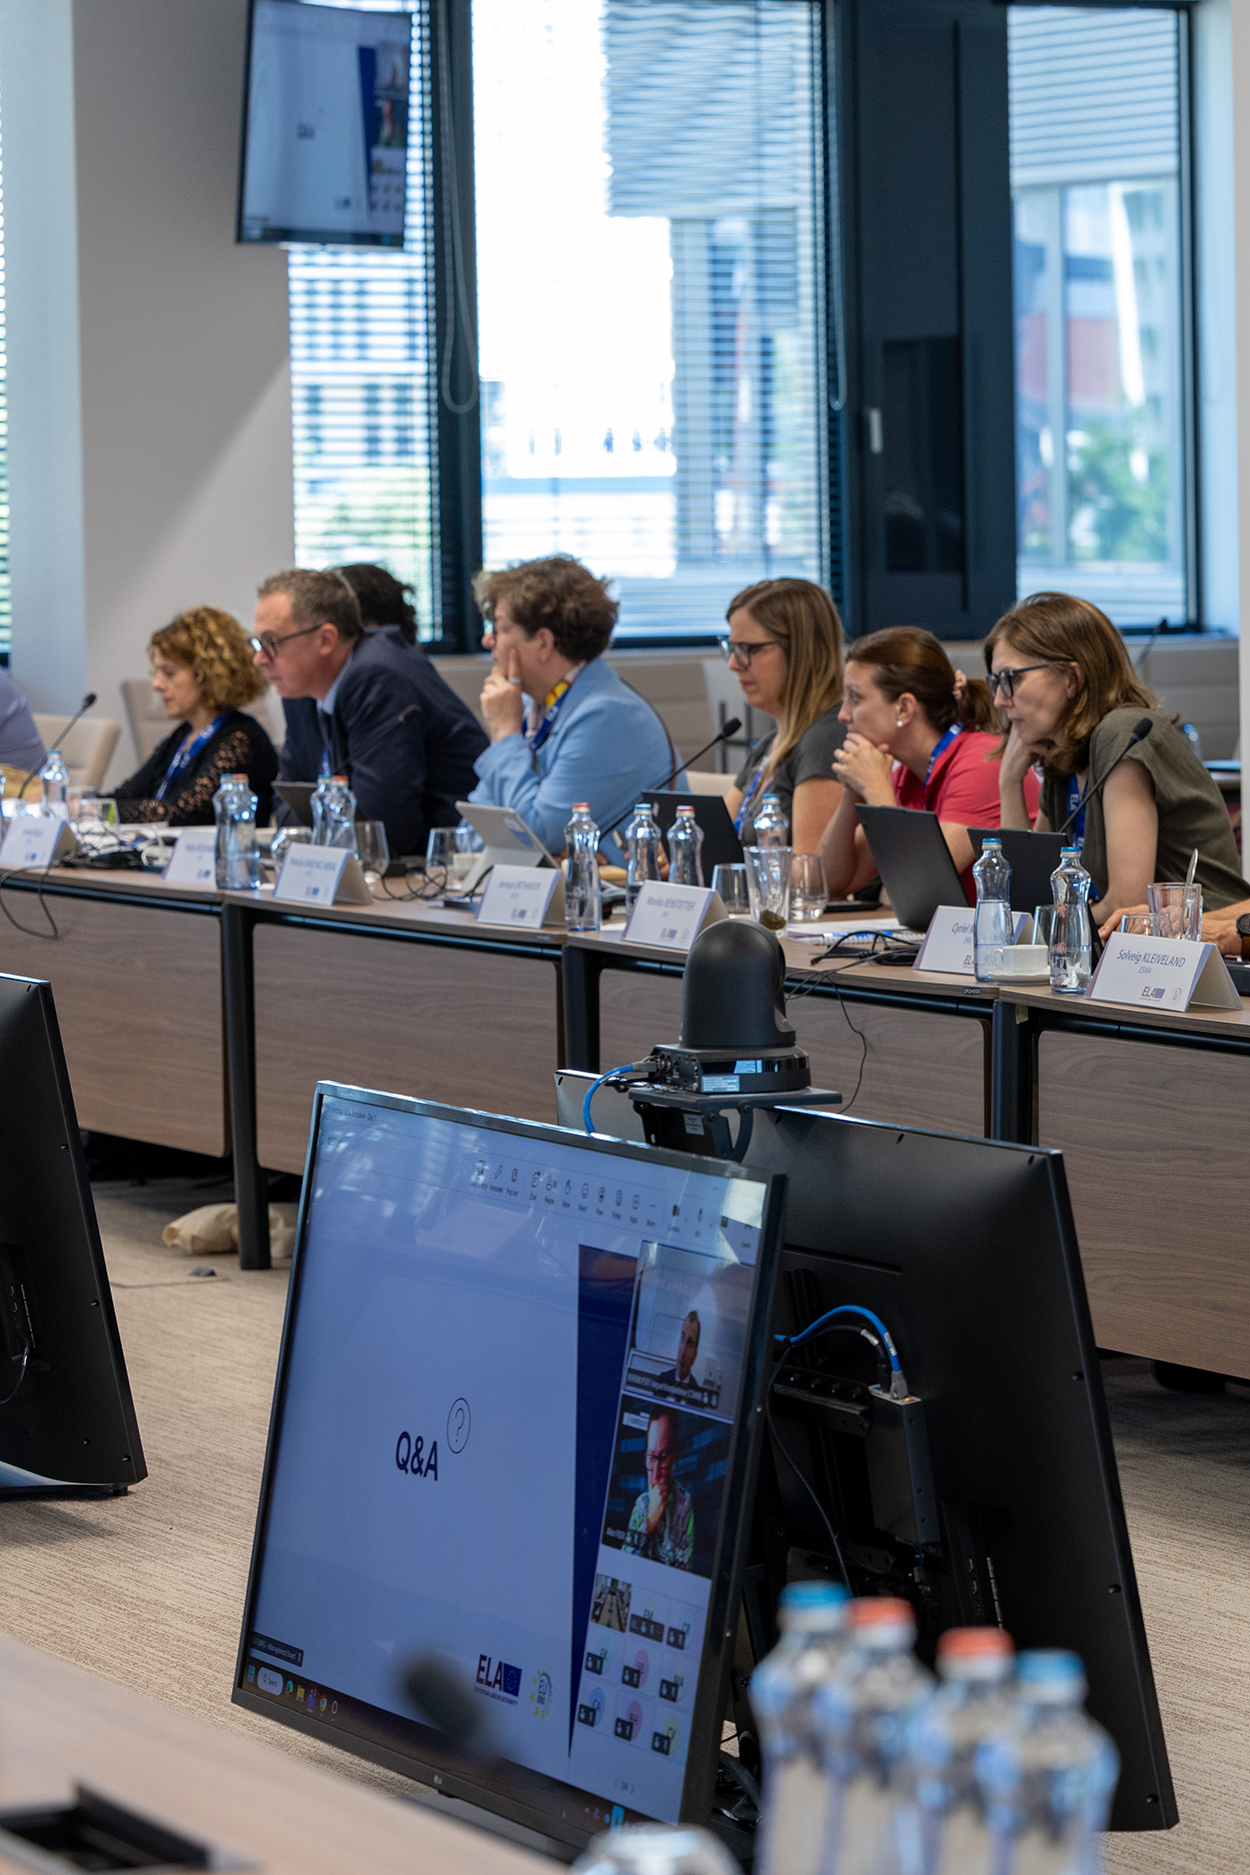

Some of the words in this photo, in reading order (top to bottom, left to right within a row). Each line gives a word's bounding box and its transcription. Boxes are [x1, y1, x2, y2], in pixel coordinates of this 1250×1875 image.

[1117, 949, 1141, 964] Solveig
[1141, 952, 1186, 968] KLEIVELAND
[1141, 986, 1156, 998] ELA
[396, 1431, 438, 1482] Q&A
[476, 1654, 502, 1692] ELA
